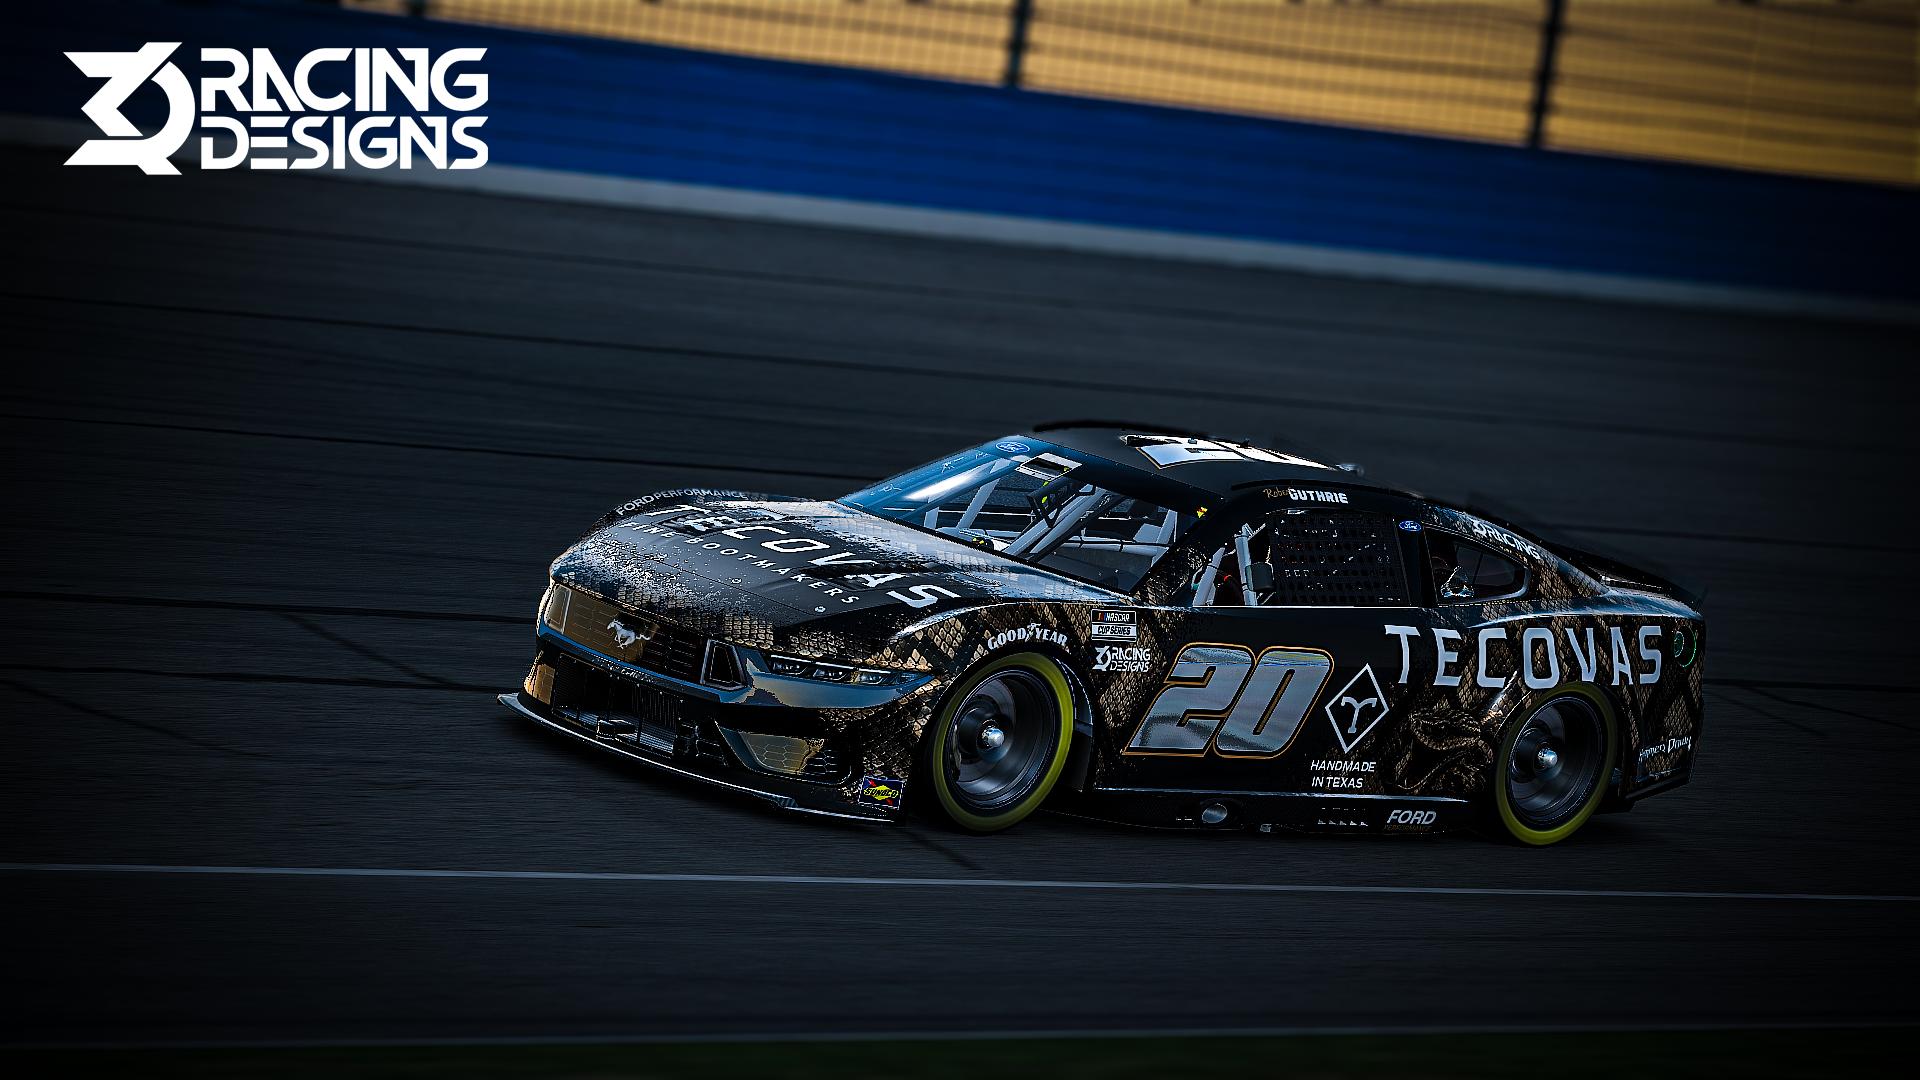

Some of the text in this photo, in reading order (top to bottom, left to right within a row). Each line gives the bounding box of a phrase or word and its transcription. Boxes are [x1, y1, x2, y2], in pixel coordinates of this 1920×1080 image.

[616, 488, 748, 516] FORD PERFORMANCE
[1288, 488, 1348, 504] GUTHRIE
[645, 504, 961, 608] TECOVAS
[684, 537, 860, 604] BOOTMAKERS
[1105, 612, 1130, 622] NASCAR
[1098, 625, 1131, 636] CUP SERIES
[1111, 647, 1151, 661] RACING
[1384, 624, 1662, 690] TECOVAS
[1110, 660, 1150, 672] DESIGNS
[1122, 643, 1334, 758] 20
[1310, 760, 1377, 772] HANDMADE
[1311, 776, 1364, 789] IN TEXAS
[864, 787, 899, 799] SUNOCO
[1386, 809, 1437, 825] FORD
